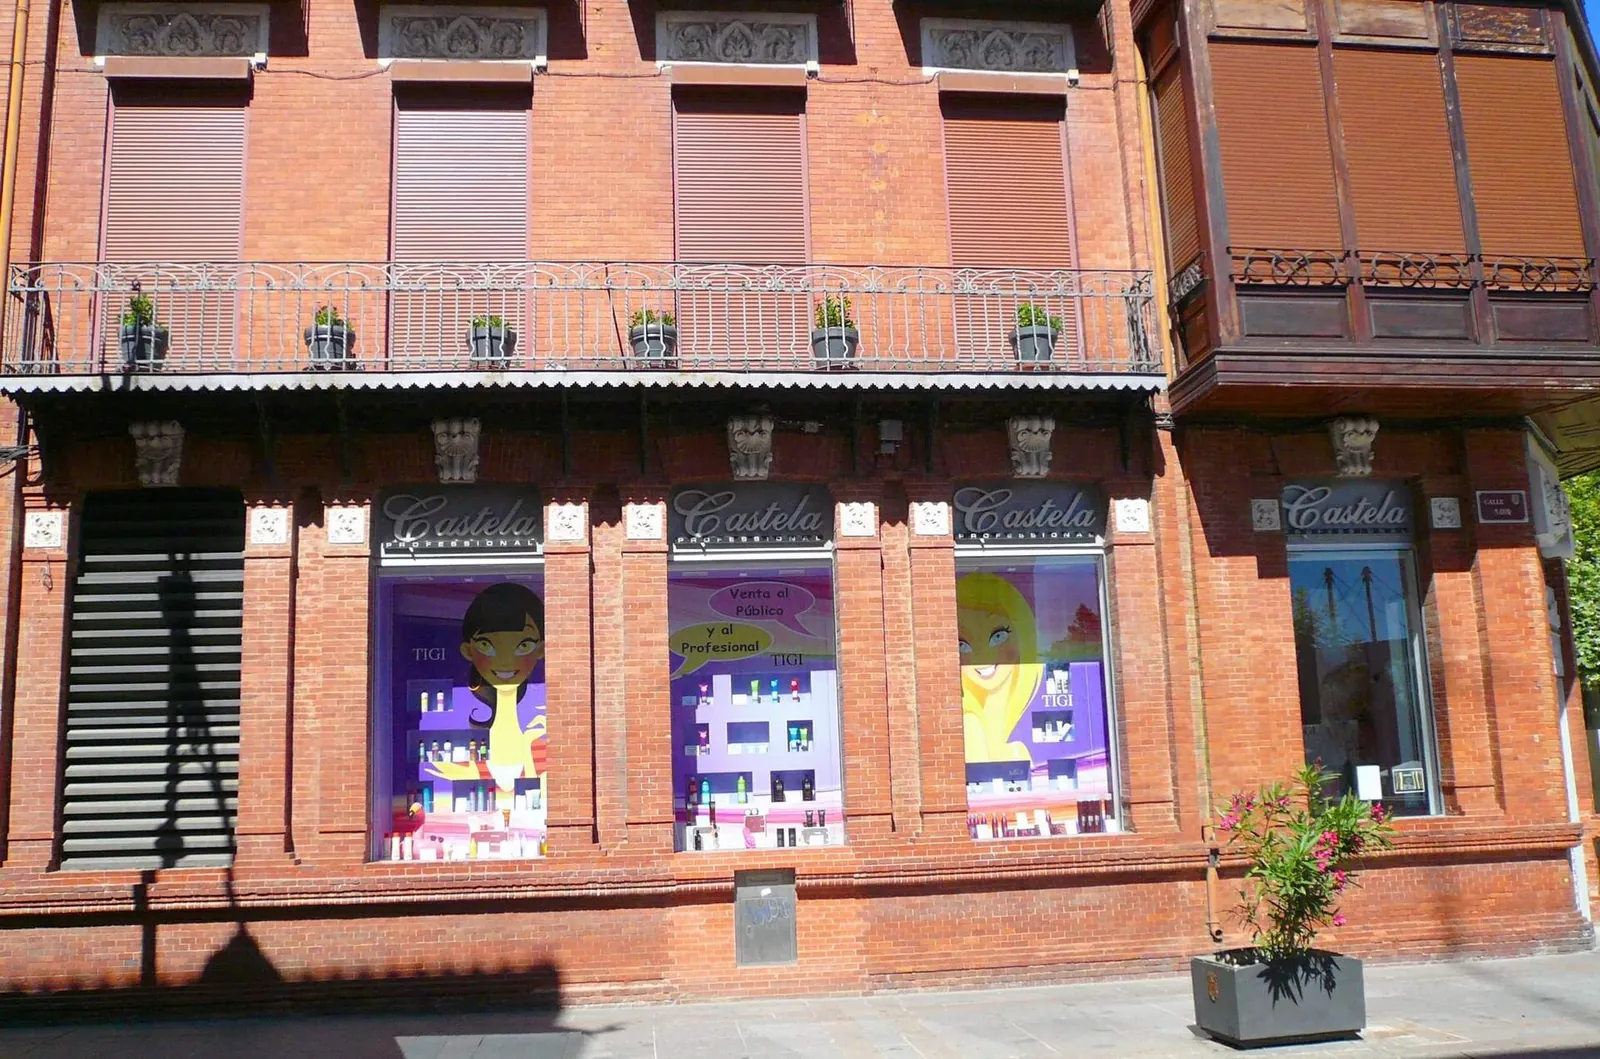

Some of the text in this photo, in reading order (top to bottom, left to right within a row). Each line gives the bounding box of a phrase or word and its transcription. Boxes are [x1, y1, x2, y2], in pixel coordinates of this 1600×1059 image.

[673, 490, 823, 537] Castela
[953, 487, 1097, 533] Castela
[1282, 485, 1405, 529] Castela
[383, 494, 536, 542] Castela
[385, 539, 536, 547] PROFESSIONAL
[730, 587, 789, 599] Venta al
[736, 605, 784, 617] Público
[706, 624, 733, 638] y al
[412, 647, 446, 661] TIGI
[681, 641, 759, 653] Profesional
[770, 653, 804, 667] TIGI
[1041, 694, 1074, 708] TIGI
